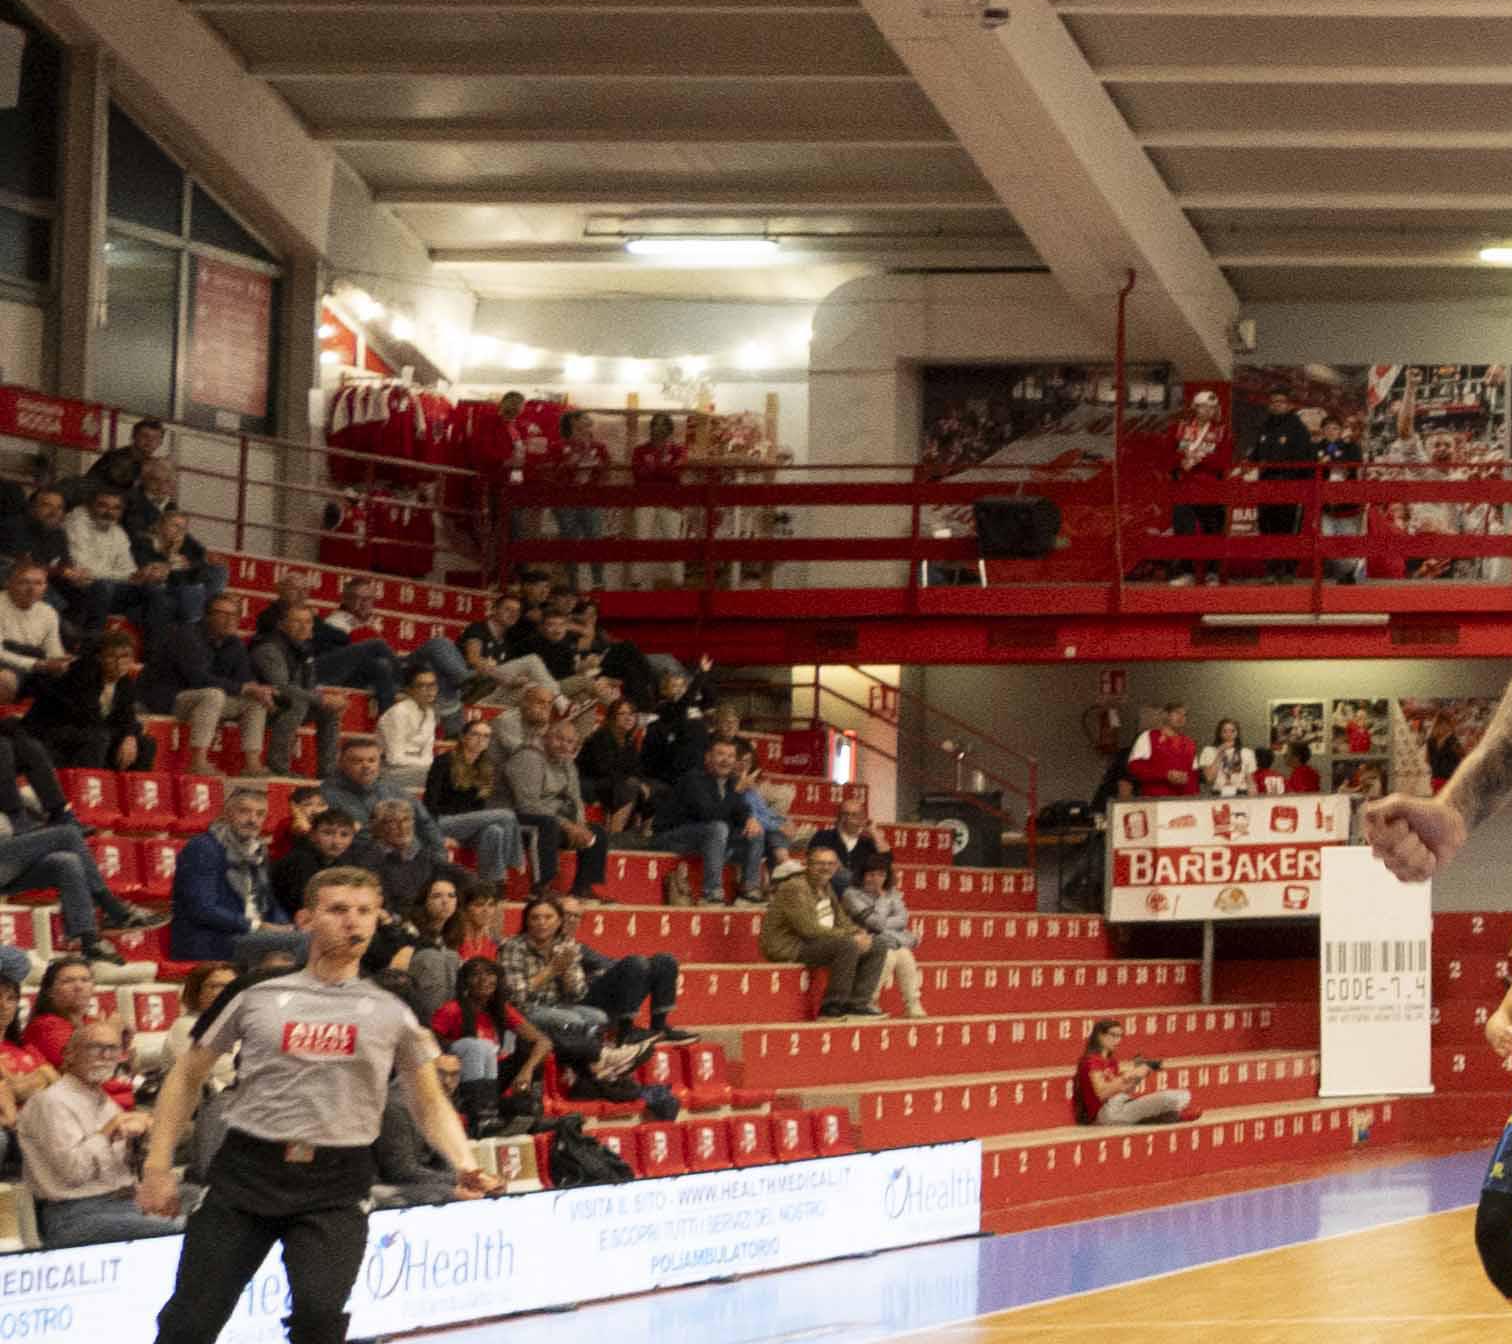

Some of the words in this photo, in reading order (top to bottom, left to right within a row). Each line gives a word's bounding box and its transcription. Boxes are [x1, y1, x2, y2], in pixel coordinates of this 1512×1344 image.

[618, 858, 626, 879] 7
[648, 860, 657, 879] 8
[1119, 846, 1321, 885] BARBAKER
[1472, 917, 1483, 933] 2
[1450, 962, 1461, 978] 2
[1475, 1008, 1487, 1024] 3
[1454, 1055, 1465, 1071] 3
[1503, 1053, 1512, 1070] 4
[405, 1230, 514, 1291] Health
[3, 1259, 121, 1296] EDICAL.IT
[1, 1305, 73, 1339] OSTRO
